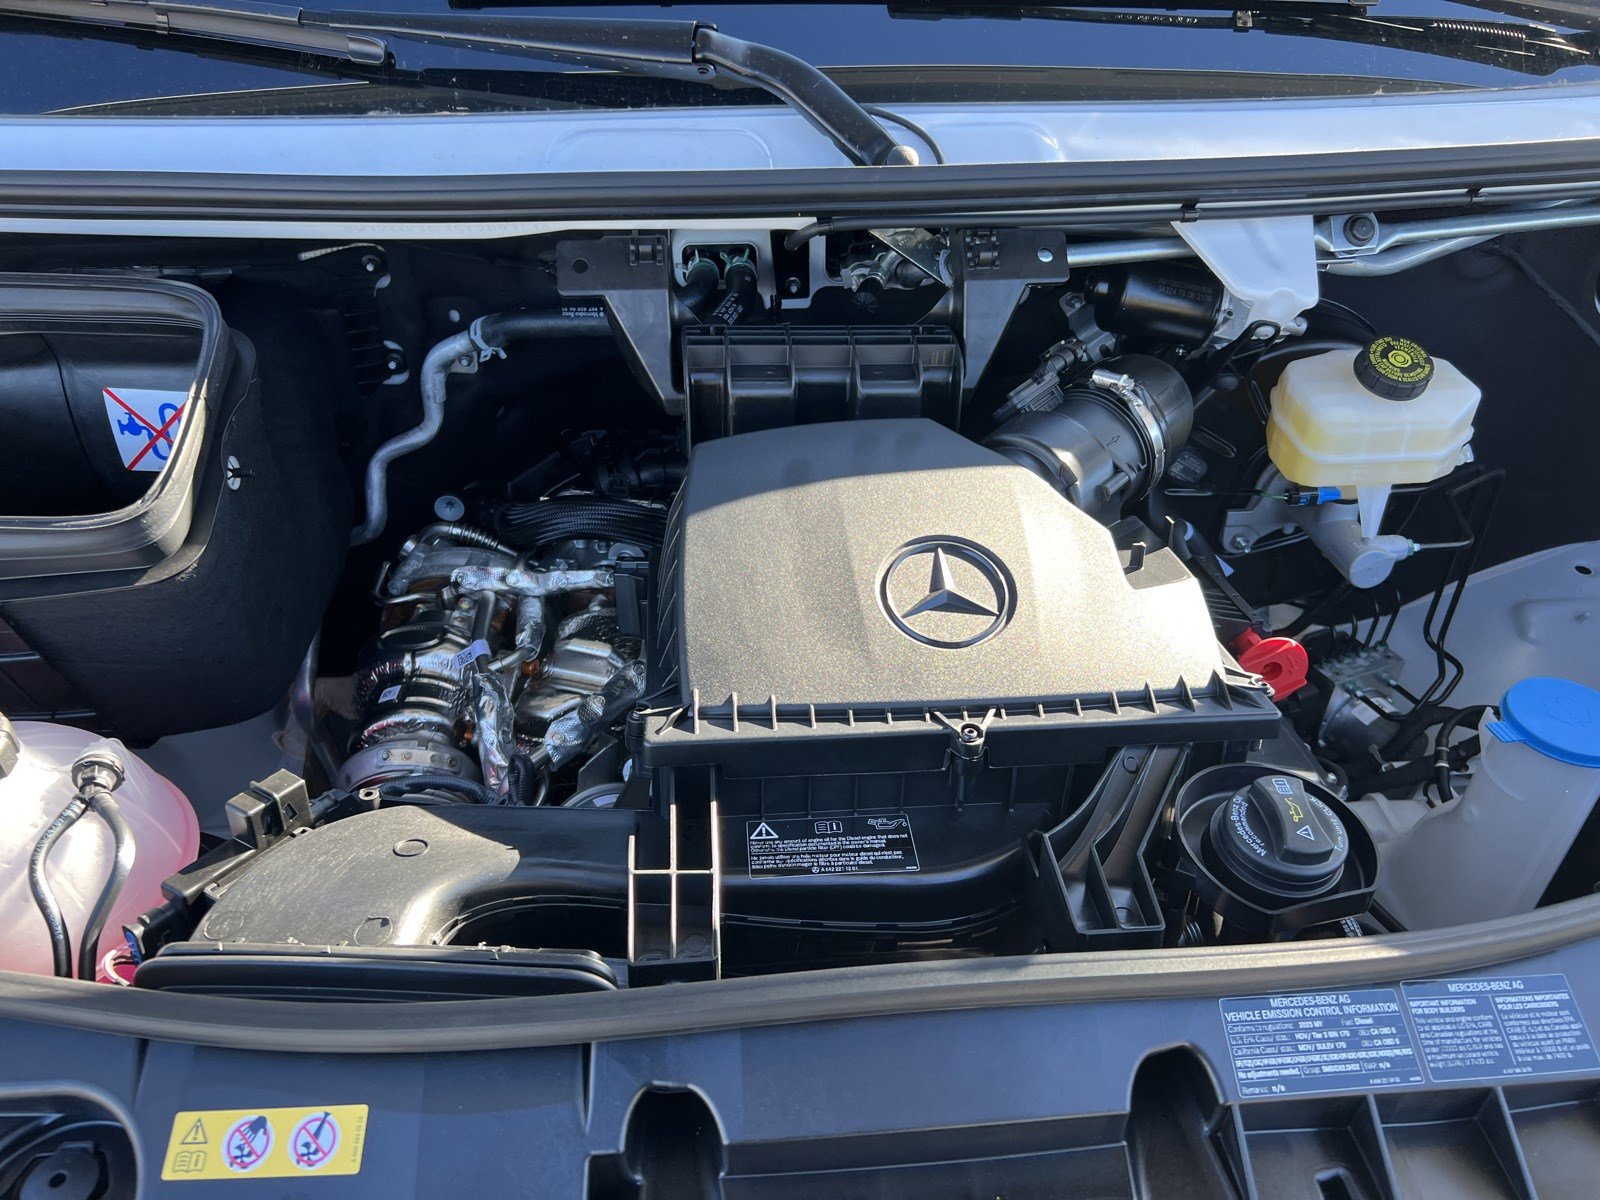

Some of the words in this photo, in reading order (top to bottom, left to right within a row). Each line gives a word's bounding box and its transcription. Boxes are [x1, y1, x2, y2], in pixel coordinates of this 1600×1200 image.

[1310, 796, 1332, 816] CLICK
[1230, 804, 1266, 856] Mercedes-Benz
[1238, 801, 1266, 846] recommended
[1334, 836, 1343, 852] Turn
[1447, 980, 1512, 992] MERCEDES-BENZ
[1512, 980, 1524, 989] AG
[1269, 995, 1338, 1008] MERCEDES-BENZ
[1338, 994, 1351, 1004] AG
[1224, 1010, 1262, 1022] VEHICLE
[1262, 1008, 1303, 1020] EMISSION
[1304, 1006, 1343, 1017] CONTROL
[1343, 1002, 1399, 1015] INFORMATION
[1354, 1017, 1374, 1026] Diesel
[1237, 1071, 1247, 1079] No
